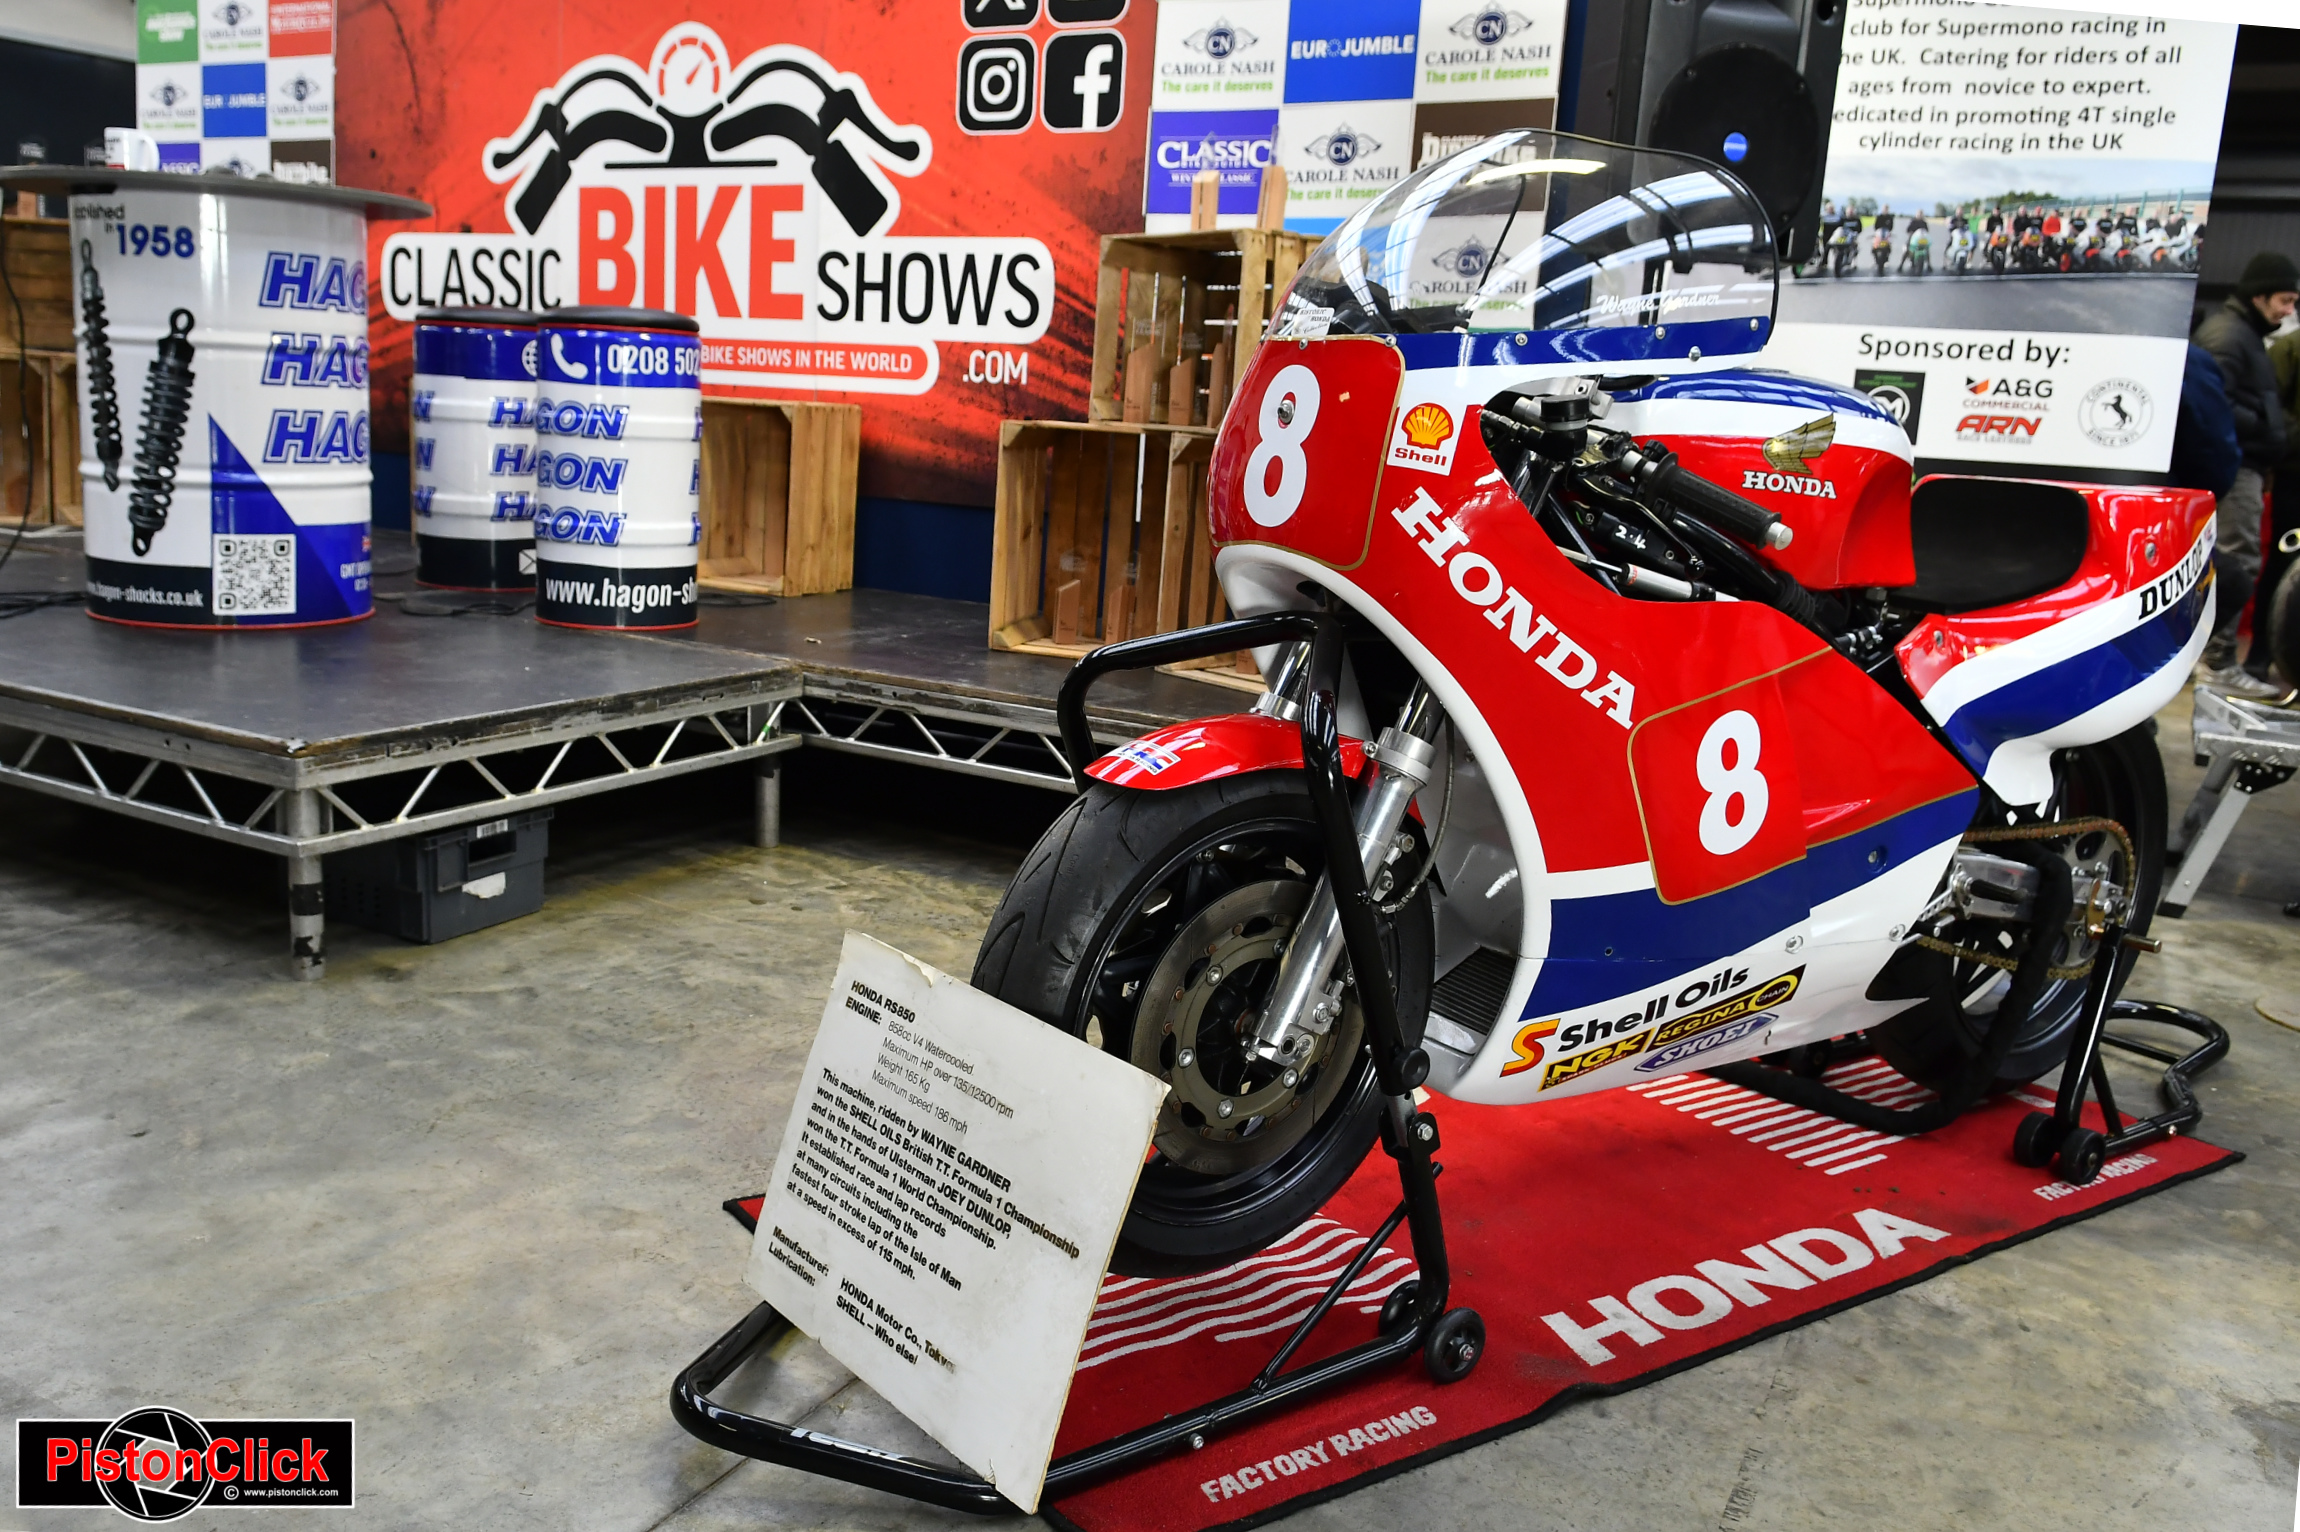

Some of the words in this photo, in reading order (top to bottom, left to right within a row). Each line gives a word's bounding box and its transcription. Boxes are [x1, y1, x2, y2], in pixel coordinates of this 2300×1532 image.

[1850, 19, 1893, 36] club
[1901, 18, 1930, 35] for
[1938, 19, 2064, 40] Supermono
[2071, 16, 2139, 38] racing
[2145, 16, 2166, 34] in
[1161, 61, 1226, 76] CAROLE
[1230, 59, 1275, 74] NASH
[1424, 49, 1496, 67] CAROLE
[1500, 44, 1551, 62] NASH
[1426, 69, 1447, 83] The
[1450, 71, 1477, 82] care
[1481, 67, 1490, 80] it
[1493, 67, 1549, 80] deserves
[1871, 48, 1905, 65] UK.
[1920, 48, 2009, 70] Catering
[2016, 47, 2047, 65] for
[2054, 46, 2118, 64] riders
[2125, 45, 2149, 64] of
[2154, 45, 2182, 64] all
[1162, 80, 1181, 92] The
[1185, 82, 1209, 92] care
[1212, 80, 1222, 92] it
[1224, 80, 1274, 92] deserves
[1848, 81, 1894, 98] ages
[1902, 76, 1952, 94] from
[1964, 78, 2035, 95] novice
[2043, 79, 2065, 95] to
[2072, 78, 2151, 98] expert.
[1930, 106, 1948, 123] in
[1955, 106, 2071, 127] promoting
[2077, 106, 2105, 123] 4T
[2112, 105, 2176, 128] single
[1156, 140, 1272, 169] CLASSIC
[1859, 131, 1942, 152] cylinder
[1949, 132, 2014, 155] racing
[2020, 132, 2040, 150] in
[2048, 132, 2084, 150] the
[2092, 133, 2124, 150] UK
[1287, 169, 1348, 185] CAROLE
[1354, 167, 1399, 182] NASH
[116, 223, 196, 259] 1958
[578, 184, 804, 321] BIKE
[389, 246, 562, 310] CLASSIC
[817, 251, 1041, 328] SHOWS
[1596, 292, 1660, 317] Wayne
[606, 344, 670, 375] 0208
[700, 344, 735, 367] BIKE
[737, 345, 793, 369] SHOWS
[796, 347, 810, 369] IN
[814, 349, 845, 370] THE
[850, 350, 913, 374] WORLD
[961, 349, 1029, 386] .COM
[1858, 333, 2015, 361] Sponsored
[2023, 339, 2071, 369] by:
[1962, 399, 2051, 412] COMMERCIAL
[1992, 378, 2054, 399] A&G
[1244, 363, 1321, 528] 8
[1955, 414, 2043, 437] ARN
[1394, 448, 1448, 467] Shell
[1742, 470, 1838, 500] HONDA
[2137, 537, 2204, 621] DUNLOP
[1389, 486, 1638, 731] HONDA
[1695, 708, 1770, 857] 8
[844, 995, 883, 1026] ENGINE:
[888, 1020, 912, 1042] 858cc
[913, 1032, 924, 1048] V4
[850, 979, 884, 1007] HONDA
[883, 997, 916, 1024] RS850
[1556, 994, 1669, 1053] Shell
[1674, 966, 1750, 1009] Oils
[1654, 1000, 1746, 1043] REGINA
[1756, 985, 1790, 1004] CHAIN
[1551, 1034, 1645, 1079] NGK
[1653, 1018, 1760, 1068] SHOEI
[877, 1052, 904, 1076] Weight
[904, 1068, 920, 1085] 165
[918, 1076, 931, 1094] Kg
[882, 1036, 919, 1066] Maximum
[919, 1056, 934, 1072] HP
[933, 1067, 953, 1084] over
[953, 1075, 997, 1109] 135/12500
[995, 1099, 1014, 1120] rpm
[871, 1069, 908, 1099] Maximum
[907, 1093, 934, 1114] speed
[934, 1105, 950, 1123] 186
[948, 1116, 968, 1135] mph
[822, 1067, 840, 1087] This
[839, 1081, 877, 1113] machine,
[877, 1104, 907, 1129] ridden
[906, 1119, 920, 1139] by
[920, 1127, 958, 1160] WAYNE
[956, 1151, 1012, 1194] GARDNER
[801, 1130, 810, 1144] It
[809, 1138, 857, 1176] established
[855, 1170, 876, 1190] race
[875, 1184, 895, 1202] and
[893, 1193, 910, 1213] lap
[909, 1206, 947, 1238] records
[806, 1117, 824, 1135] won
[824, 1127, 839, 1144] the
[839, 1136, 854, 1155] T.T.
[853, 1146, 890, 1179] Formula
[892, 1172, 898, 1184] 1
[898, 1175, 927, 1203] World
[925, 1194, 997, 1251] Championship.
[810, 1102, 828, 1118] and
[827, 1109, 836, 1124] in
[836, 1116, 851, 1133] the
[850, 1124, 878, 1151] hands
[877, 1145, 890, 1157] of
[888, 1149, 937, 1190] Ulsterman
[936, 1181, 967, 1207] JOEY
[965, 1198, 1012, 1240] DUNLOP,
[816, 1085, 834, 1103] won
[834, 1095, 849, 1112] the
[849, 1104, 878, 1132] SHELL
[879, 1123, 903, 1146] OILS
[901, 1137, 934, 1167] British
[935, 1157, 952, 1178] T.T.
[950, 1168, 994, 1205] Formula
[996, 1196, 1003, 1210] 1
[1003, 1201, 1080, 1260] Championship
[796, 1149, 807, 1162] at
[806, 1155, 830, 1179] many
[829, 1172, 862, 1200] circuits
[861, 1191, 902, 1231] including
[902, 1220, 919, 1240] the
[786, 1181, 797, 1194] at
[796, 1188, 803, 1198] a
[803, 1192, 829, 1216] speed
[827, 1207, 837, 1223] in
[836, 1217, 866, 1244] excess
[866, 1239, 879, 1252] of
[878, 1244, 894, 1263] 115
[892, 1257, 916, 1281] mph.
[791, 1162, 821, 1191] fastest
[820, 1182, 839, 1203] four
[838, 1198, 867, 1224] stroke
[867, 1215, 882, 1235] lap
[882, 1229, 895, 1242] of
[893, 1235, 909, 1254] the
[909, 1245, 928, 1267] Isle
[928, 1262, 941, 1275] of
[939, 1266, 962, 1292] Man
[768, 1241, 816, 1287] Lubrication:
[835, 1294, 866, 1327] SHELL
[874, 1323, 895, 1348] Who
[895, 1343, 919, 1366] else!
[772, 1225, 830, 1277] Manufacturer:
[839, 1277, 874, 1313] HONDA
[874, 1303, 904, 1333] Motor
[903, 1326, 923, 1351] Co.,
[1539, 1206, 1953, 1368] HONDA
[1200, 1440, 1332, 1503] FACTORY
[1327, 1405, 1438, 1458] RACING
